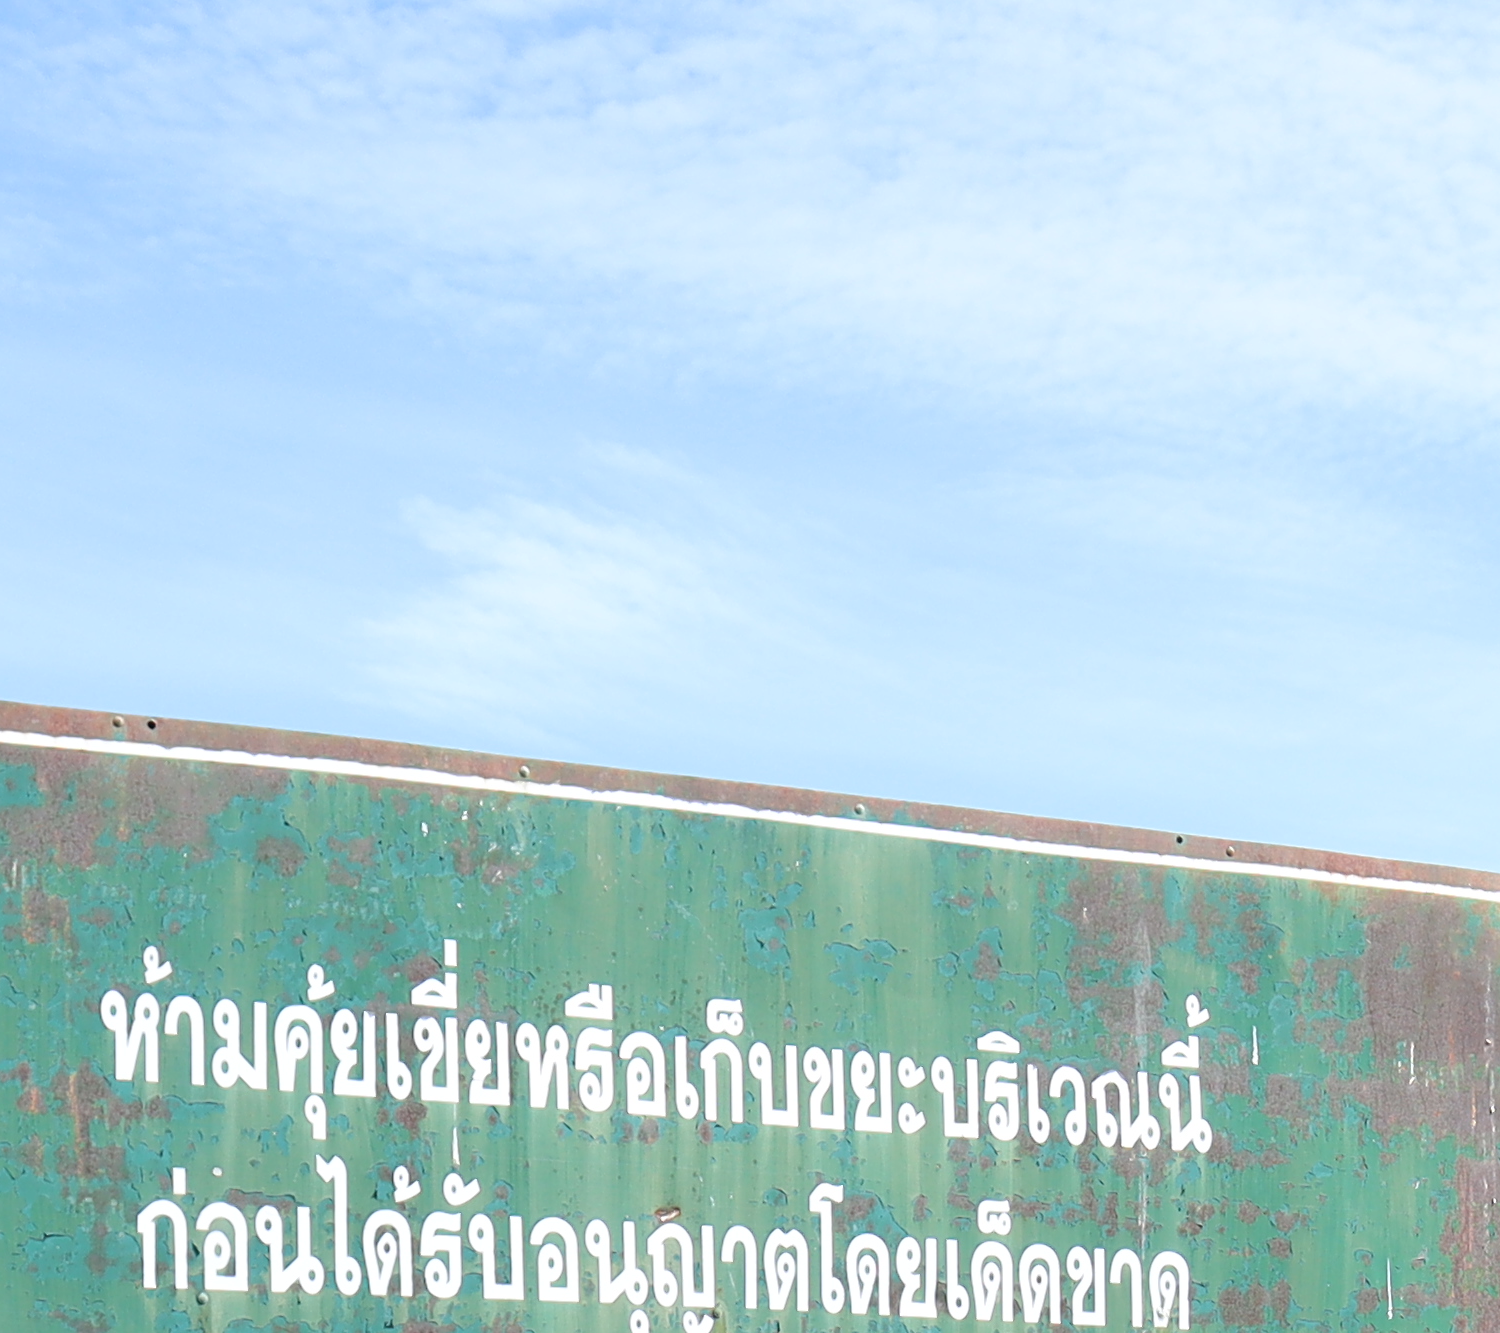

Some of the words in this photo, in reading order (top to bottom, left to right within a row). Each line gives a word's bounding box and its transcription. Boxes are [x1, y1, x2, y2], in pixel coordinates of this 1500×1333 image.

[100, 939, 1213, 1154] ห้ามคุ้ยเขี่ยหรือเก็บขยะบริเวณนี้
